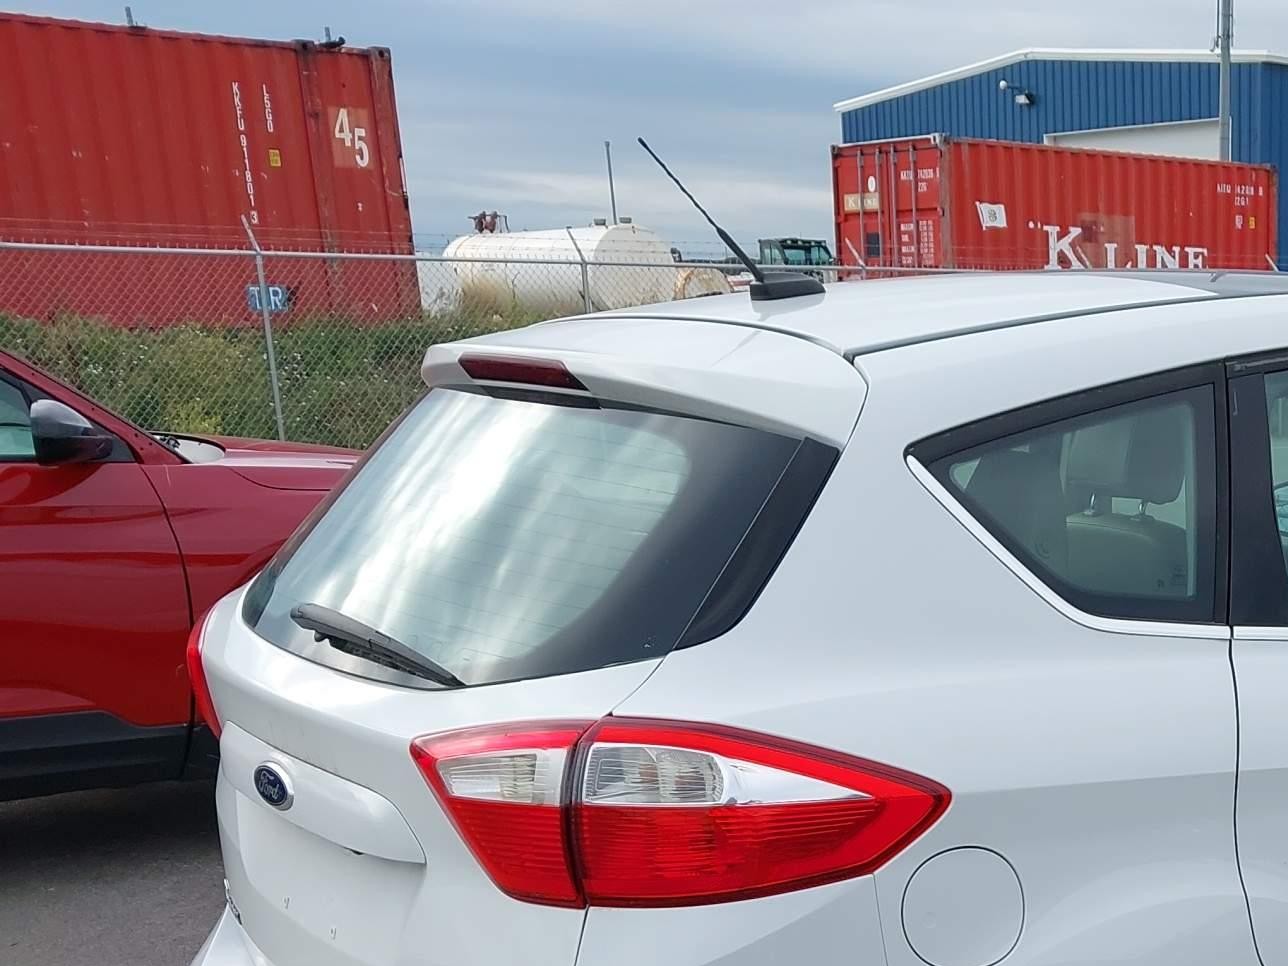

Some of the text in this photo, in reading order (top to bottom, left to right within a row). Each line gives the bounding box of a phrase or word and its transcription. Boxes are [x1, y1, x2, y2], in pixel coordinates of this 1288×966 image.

[232, 81, 246, 131] KKFU
[335, 107, 370, 168] 45
[1104, 243, 1209, 270] LINE
[249, 286, 283, 311] TR
[258, 769, 281, 800] Ford
